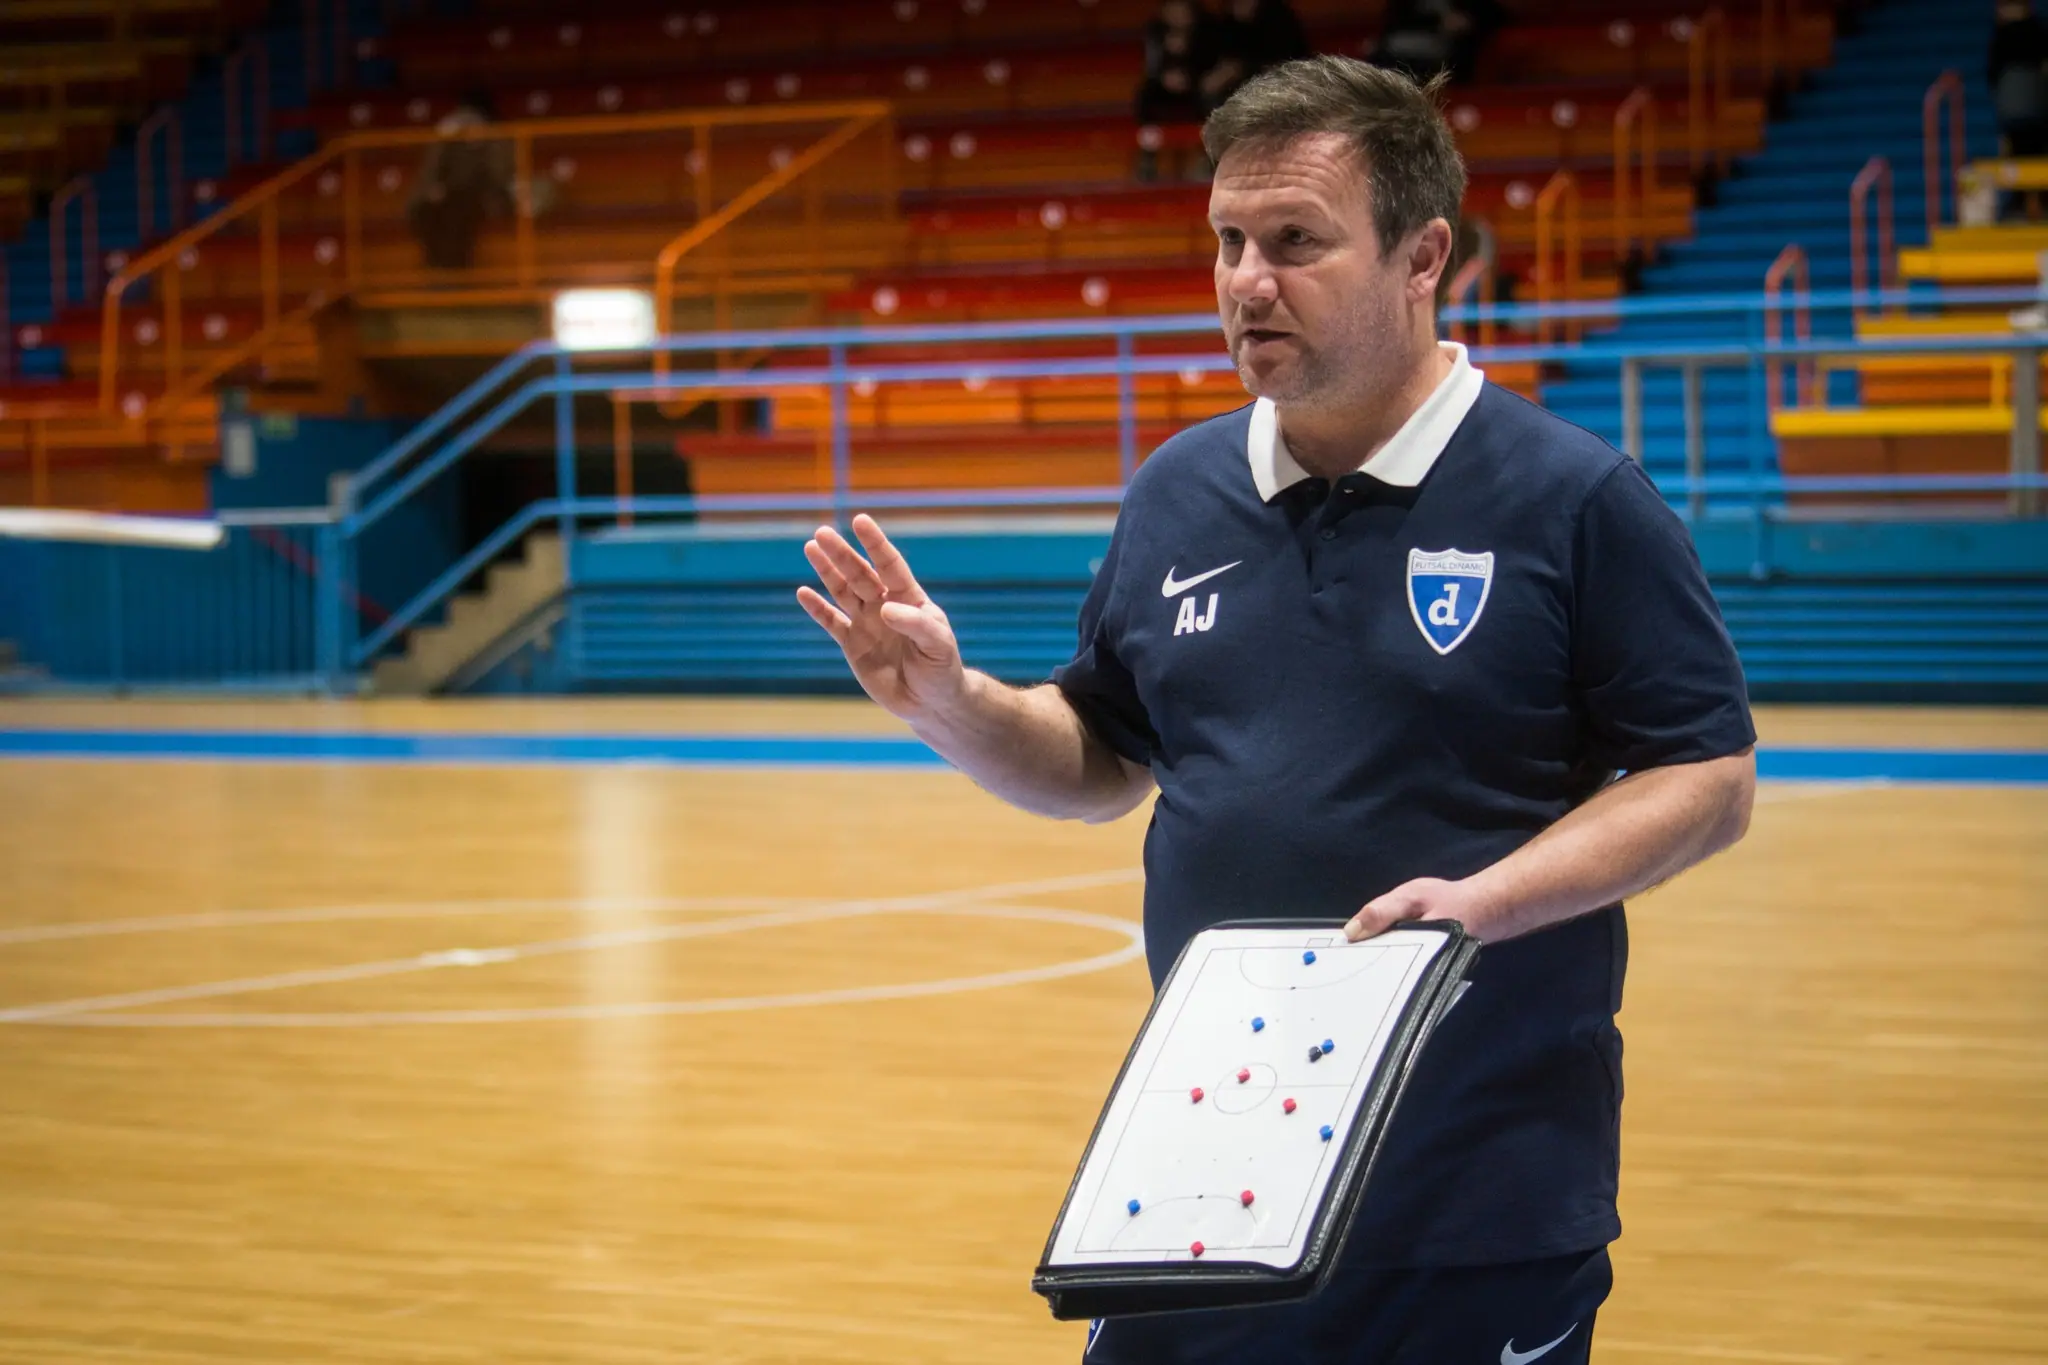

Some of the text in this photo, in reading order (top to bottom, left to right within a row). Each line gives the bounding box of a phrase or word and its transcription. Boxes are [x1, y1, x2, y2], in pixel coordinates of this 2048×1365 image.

[1415, 561, 1485, 572] FUTSAL DINAMO
[1173, 592, 1219, 636] AJ
[1428, 583, 1460, 626] d
